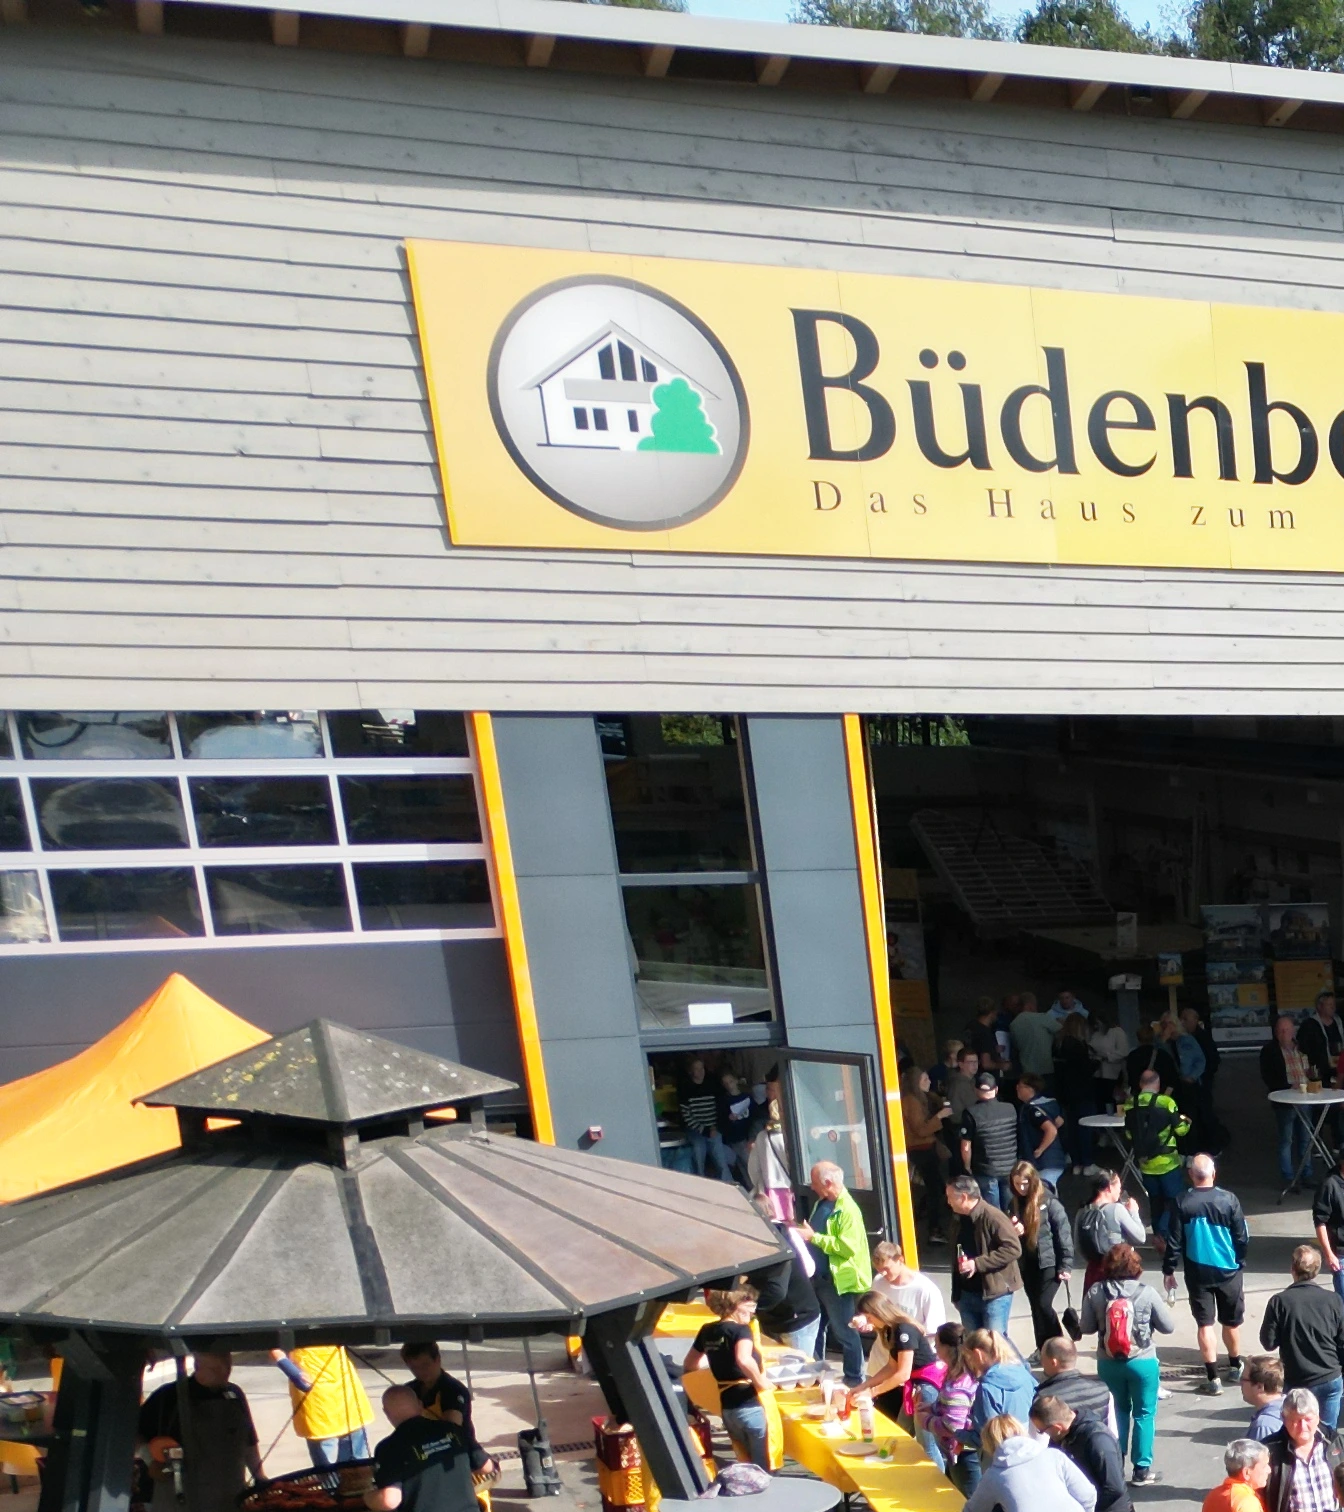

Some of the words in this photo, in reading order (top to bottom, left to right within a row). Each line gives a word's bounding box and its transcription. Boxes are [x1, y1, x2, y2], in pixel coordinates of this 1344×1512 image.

[812, 480, 928, 515] Das
[987, 487, 1137, 523] Haus
[1190, 504, 1296, 530] zum
